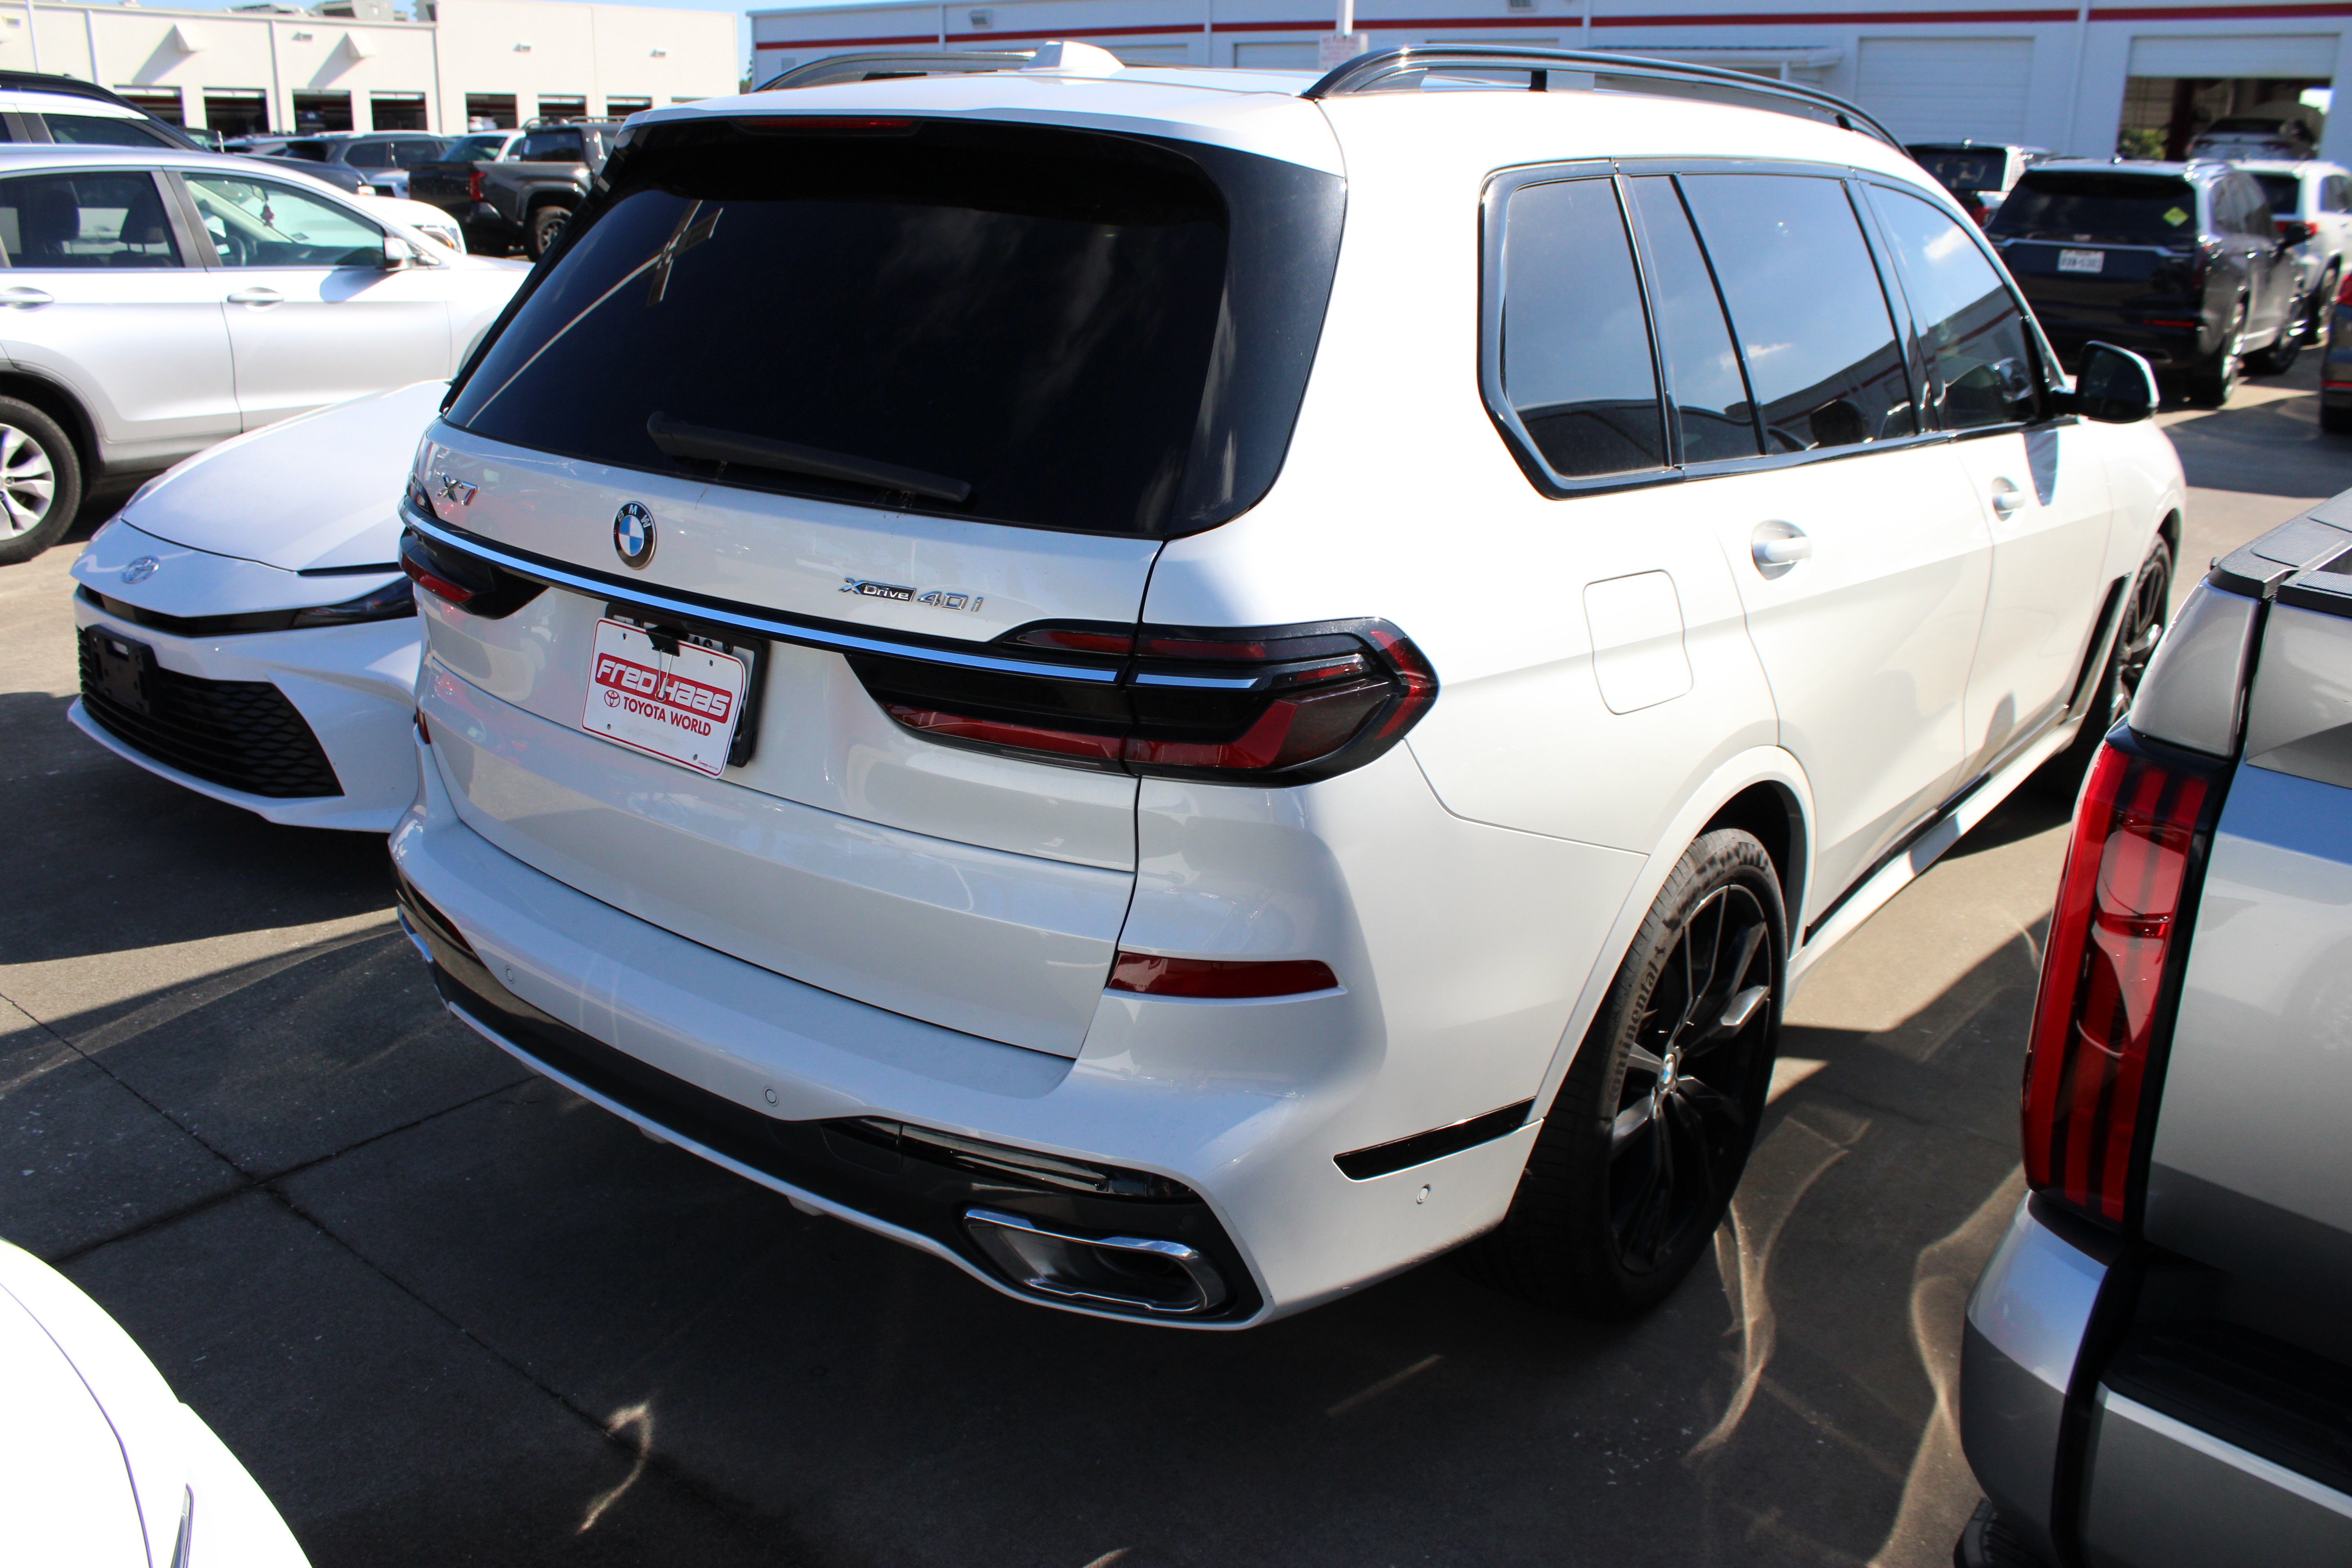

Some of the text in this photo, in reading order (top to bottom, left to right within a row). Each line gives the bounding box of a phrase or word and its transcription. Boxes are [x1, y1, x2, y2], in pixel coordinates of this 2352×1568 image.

[438, 472, 479, 506] X7
[617, 504, 651, 528] BMW
[624, 696, 711, 736] TOYOTA WORLD
[1608, 960, 1659, 1103] Continental
